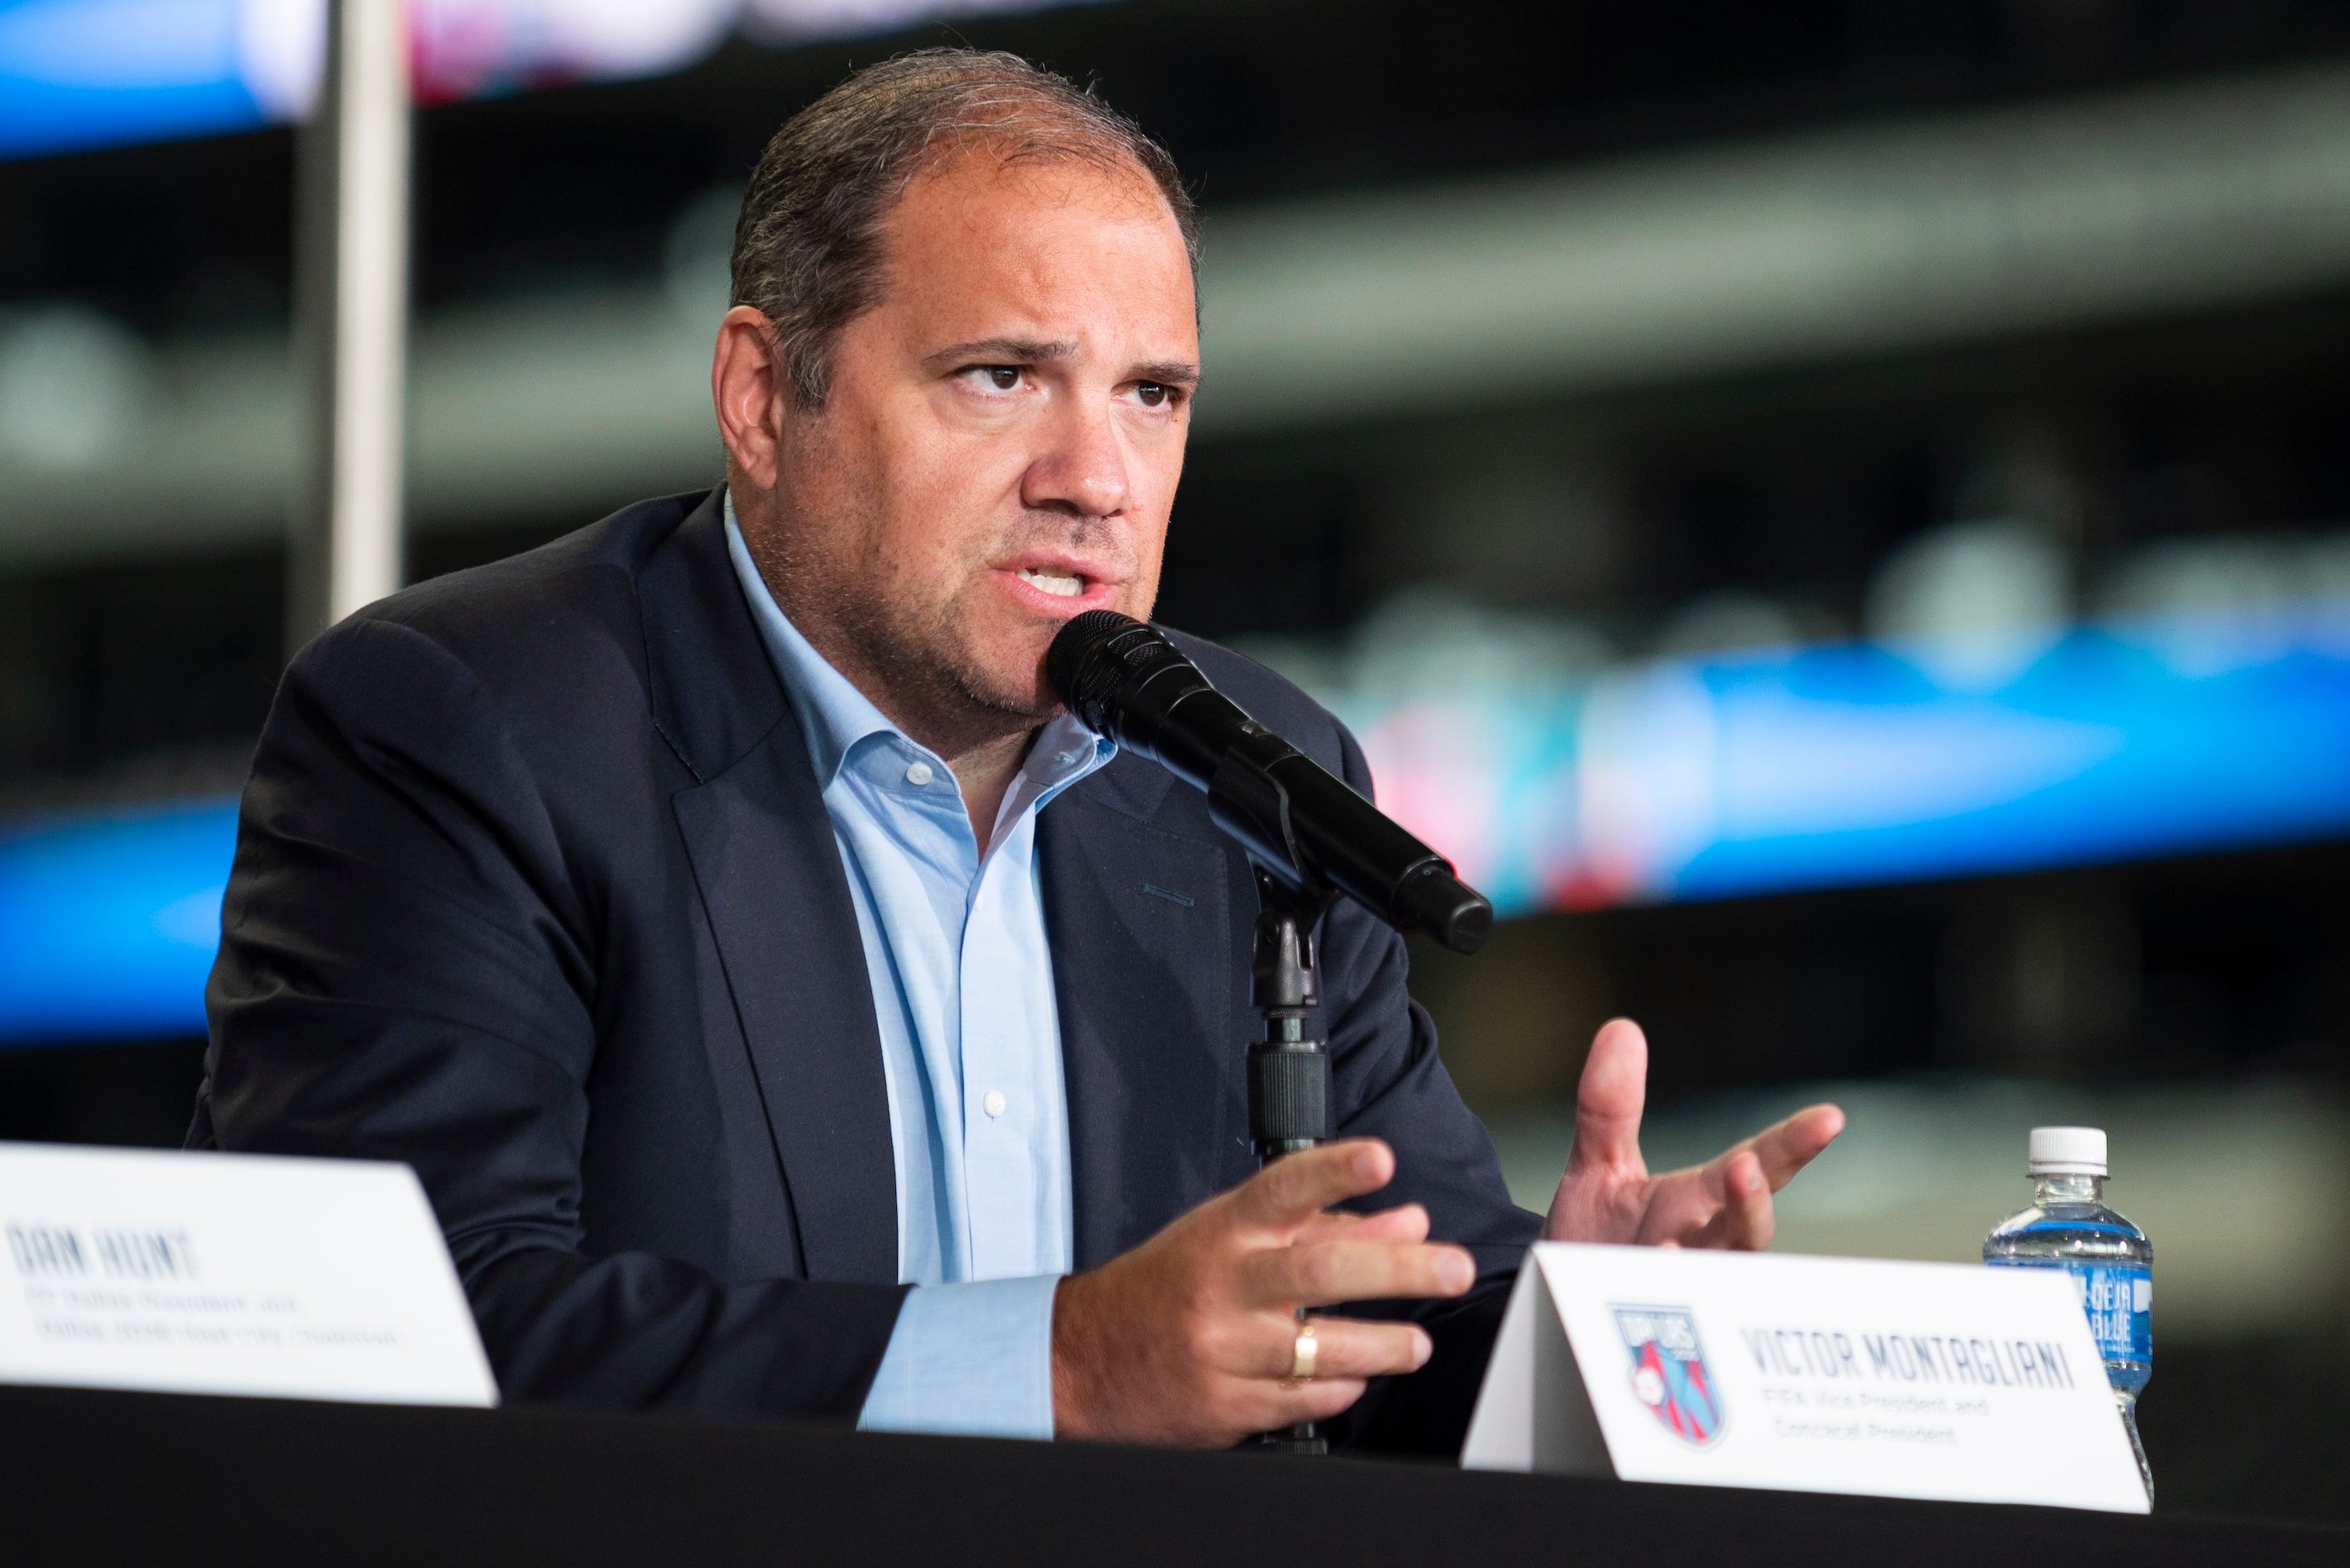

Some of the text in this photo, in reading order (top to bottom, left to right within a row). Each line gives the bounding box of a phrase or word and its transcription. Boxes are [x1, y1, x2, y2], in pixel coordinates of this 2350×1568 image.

[5, 1227, 199, 1280] DAN HUNT
[2091, 1313, 2131, 1342] BLUE
[1740, 1328, 1861, 1379] VICTOR
[1861, 1333, 2075, 1389] MONTAGLIANI
[1762, 1388, 1990, 1417] FIFA Vice President and
[1774, 1418, 1958, 1446] Concacaf President
